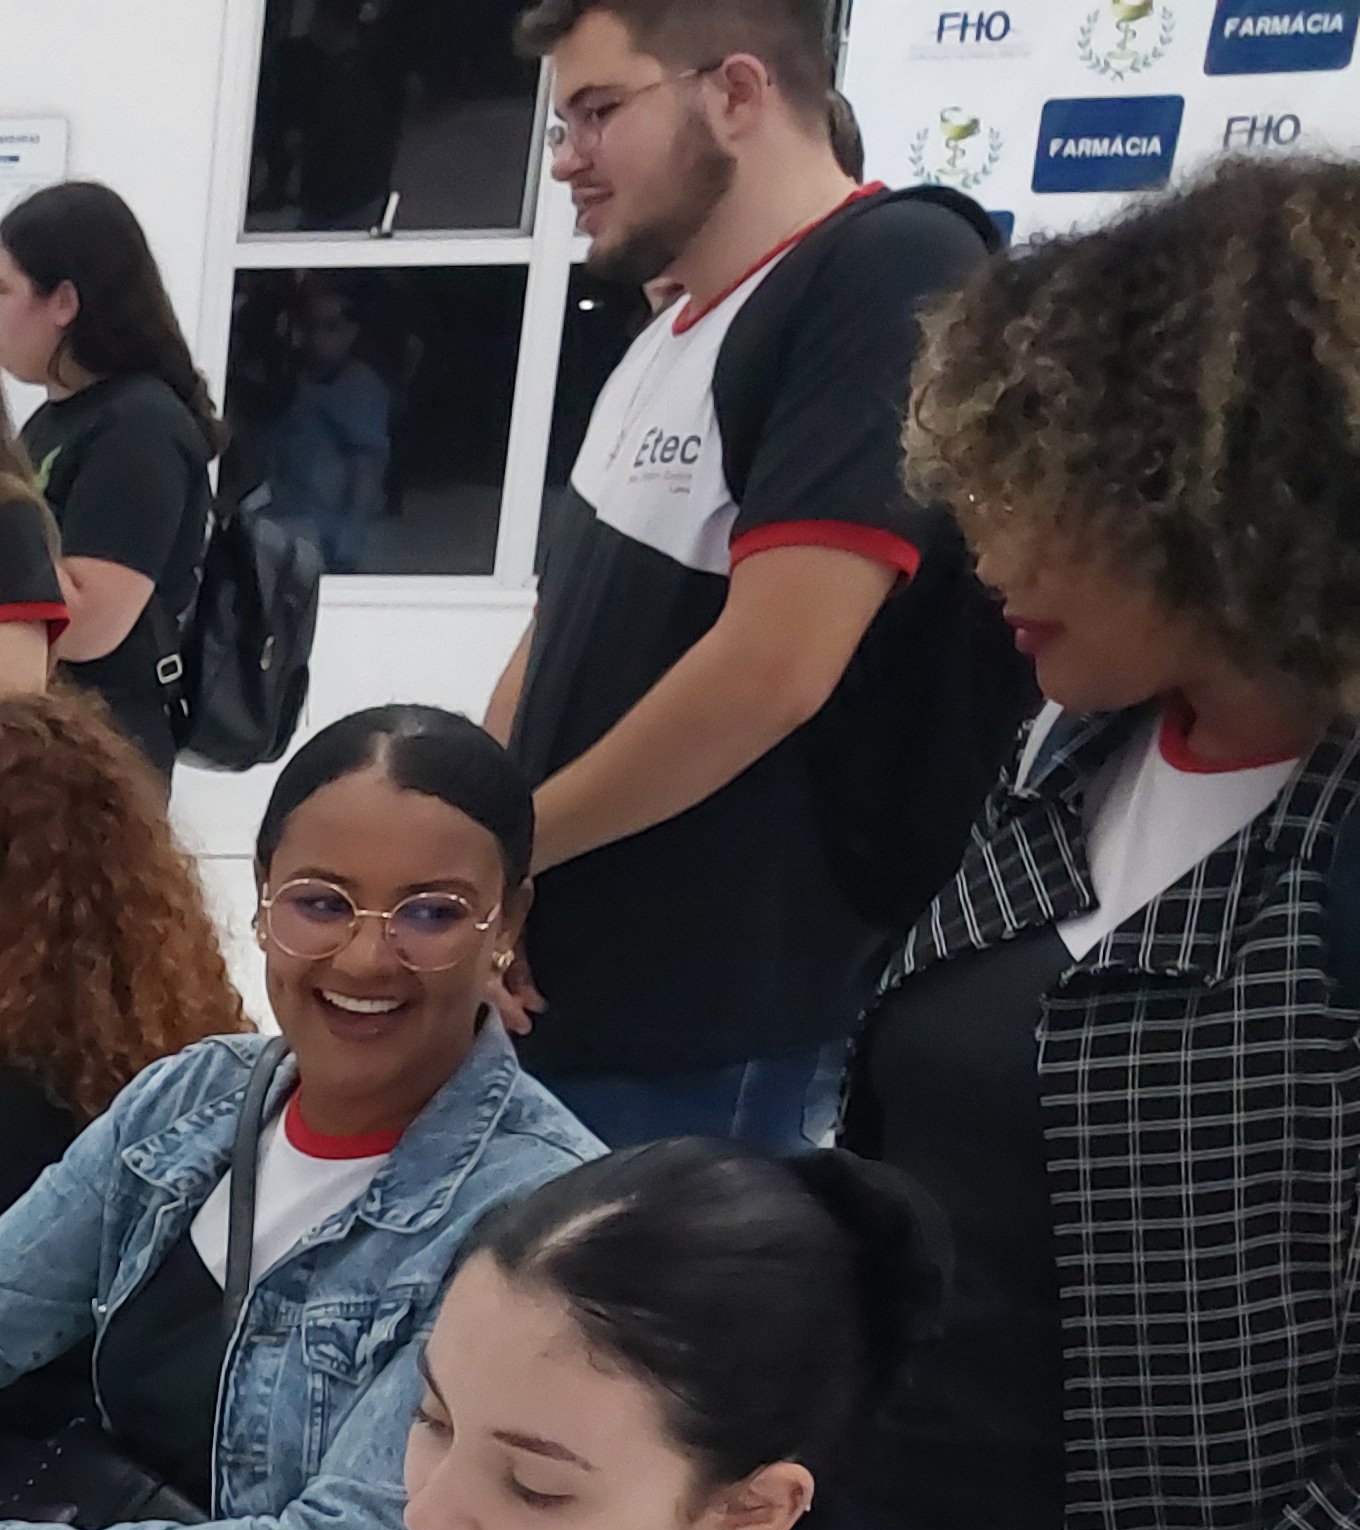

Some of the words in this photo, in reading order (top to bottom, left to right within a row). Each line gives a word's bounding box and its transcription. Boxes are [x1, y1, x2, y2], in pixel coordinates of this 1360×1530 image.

[937, 10, 1011, 44] FHO
[1223, 11, 1344, 39] FARMÁCIA
[1049, 134, 1162, 158] FARMÁCIA
[1222, 113, 1301, 153] FHO
[633, 426, 702, 468] Etec
